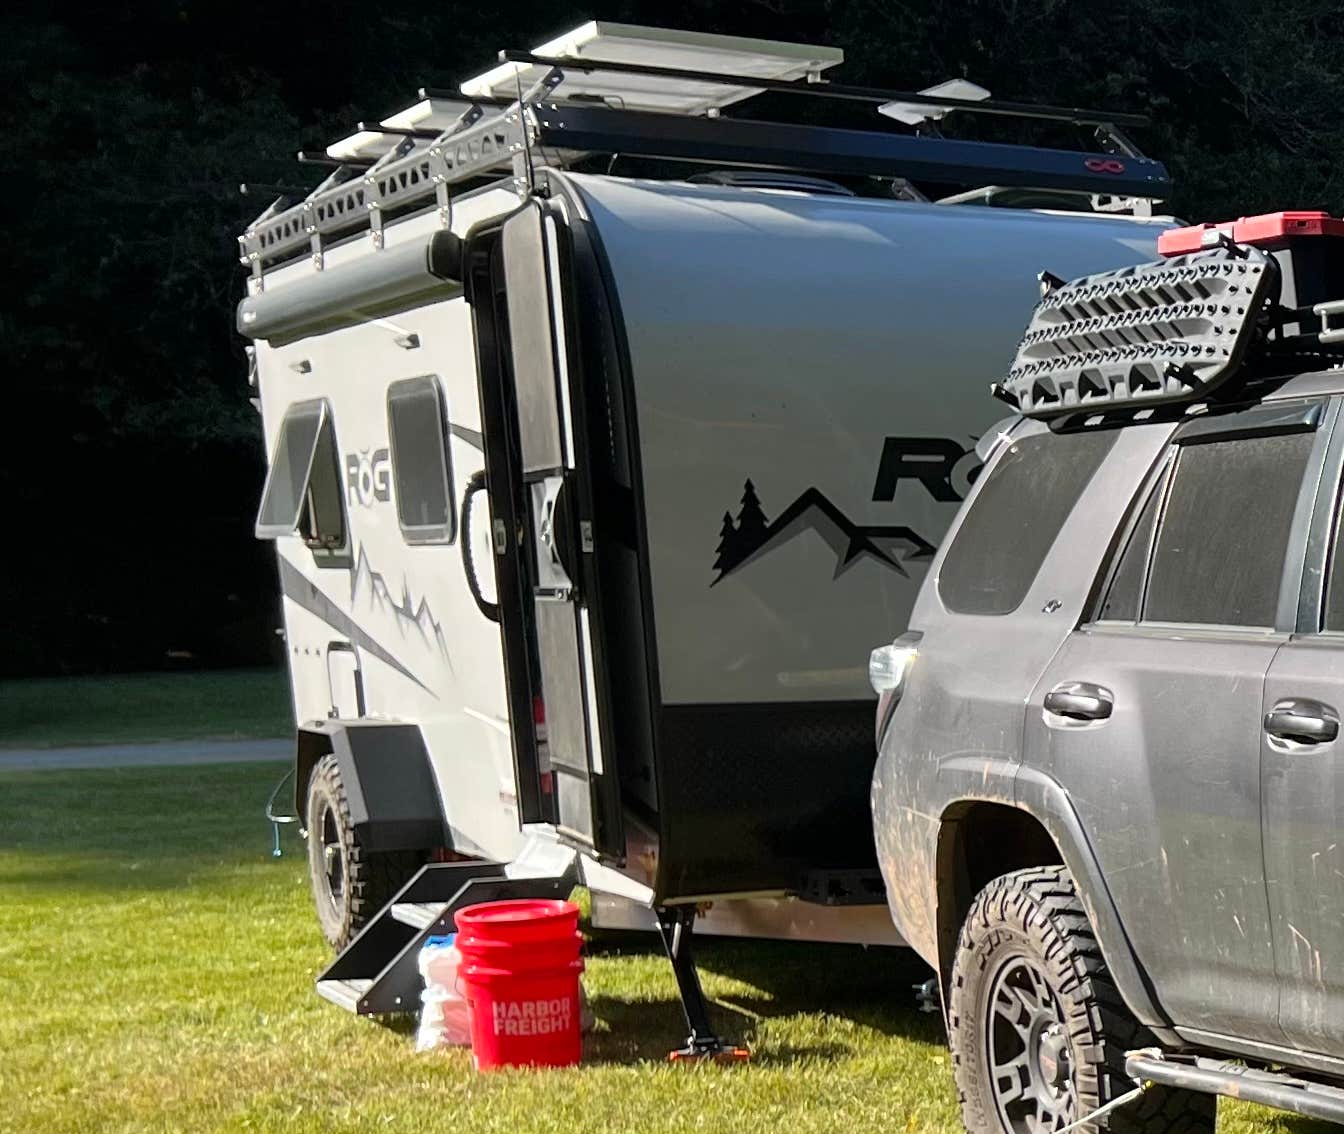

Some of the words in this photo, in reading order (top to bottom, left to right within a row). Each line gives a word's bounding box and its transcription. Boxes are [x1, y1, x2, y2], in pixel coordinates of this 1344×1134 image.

[346, 448, 391, 508] ROG
[492, 997, 571, 1018] HARBOR
[493, 1014, 571, 1036] FREIGHT
